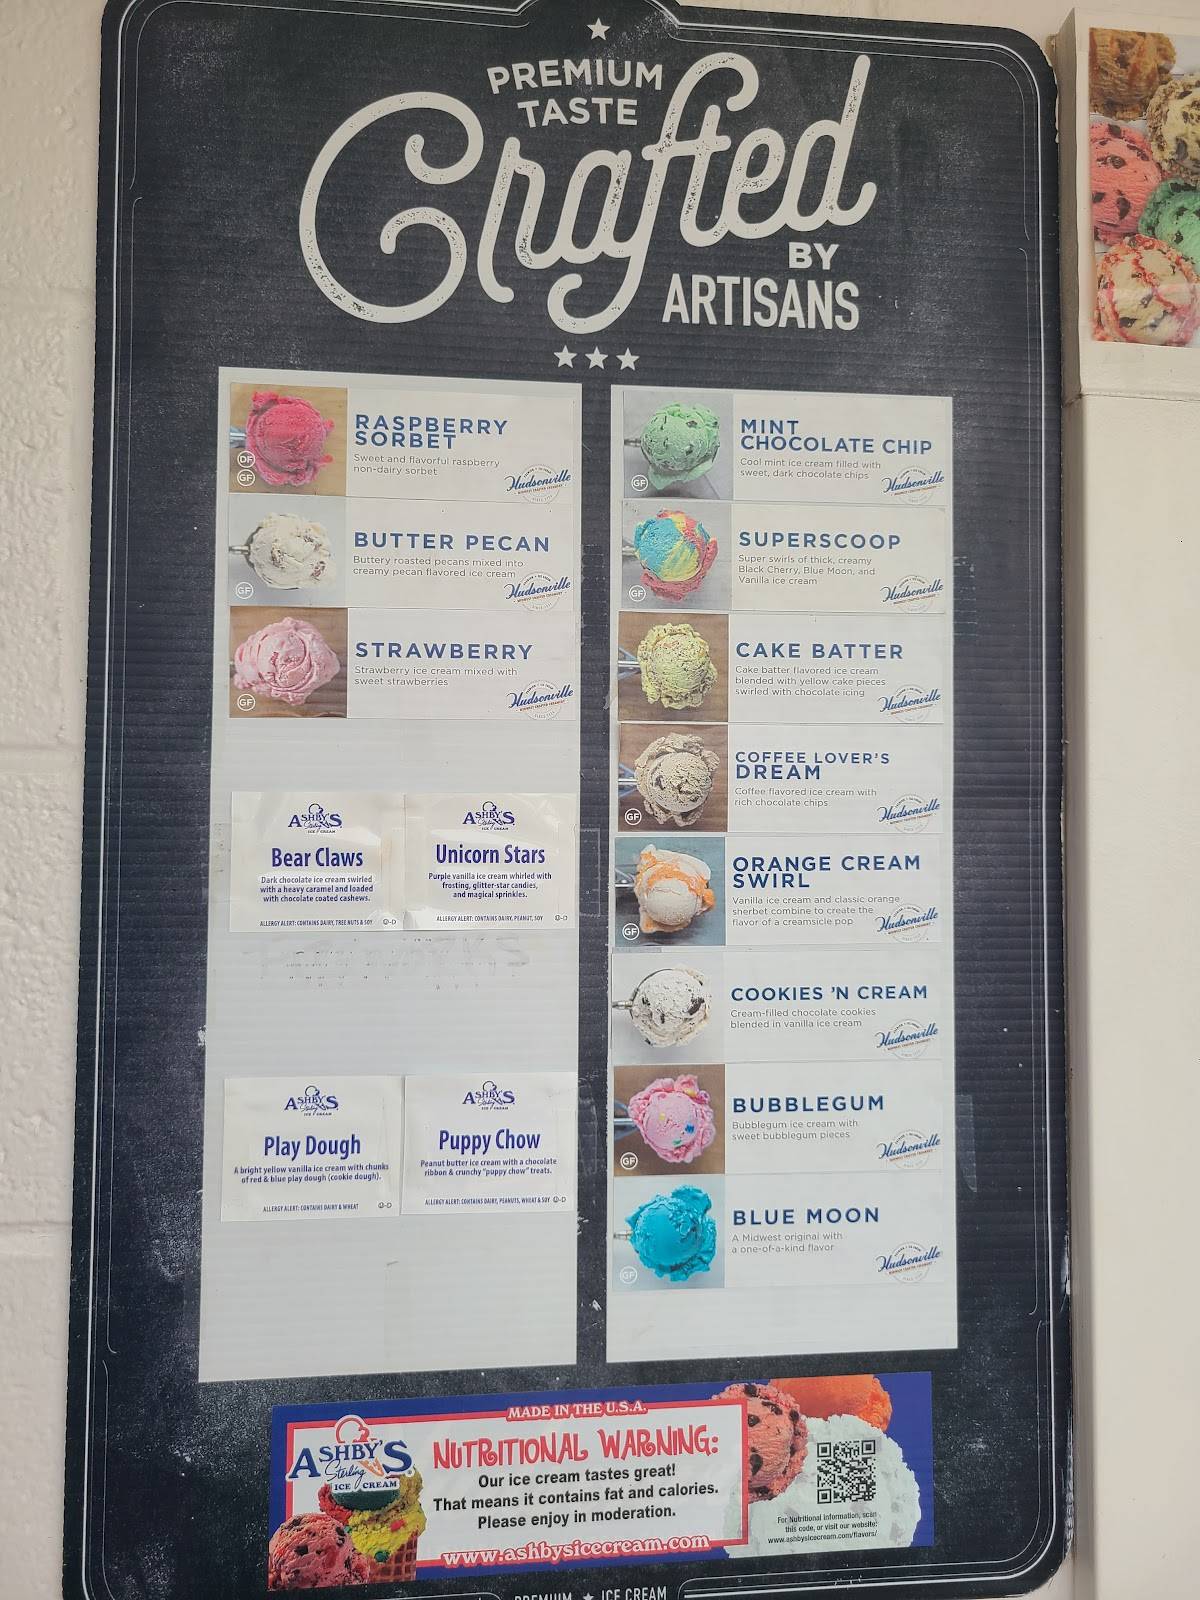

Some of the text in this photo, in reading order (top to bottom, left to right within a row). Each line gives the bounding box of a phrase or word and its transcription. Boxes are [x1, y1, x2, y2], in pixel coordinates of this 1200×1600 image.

[486, 58, 664, 95] PREMIUM
[516, 97, 639, 128] TASTE
[299, 52, 877, 335] Crafted
[787, 241, 839, 270] BY
[661, 273, 860, 331] ARTISANS
[356, 414, 507, 434] RASPBERRY
[742, 419, 798, 436] MINT
[356, 431, 456, 449] SORBET
[741, 435, 932, 454] CHOCOLATE CHIP
[354, 454, 499, 469] Sweet and flavorful raspberry
[354, 465, 438, 476] non-dairy sorbet
[504, 469, 571, 491] Hudsonville
[881, 470, 944, 493] Hudsonville
[355, 532, 548, 552] BUTTER PECAN
[740, 532, 900, 549] SUPERSCOOP
[354, 554, 525, 569] Buttery roasted pecans mixed into
[353, 567, 389, 576] creamy
[426, 568, 465, 576] flavored
[486, 569, 515, 579] cream
[504, 576, 571, 599] Hudsonville
[880, 579, 944, 602] Hudsonville
[356, 642, 532, 659] STRAWBERRY
[736, 643, 902, 659] CAKE BATTER
[508, 684, 574, 708] Hudsonville
[877, 688, 942, 713] Hudsonville
[736, 752, 889, 766] COFFEE LOVER'S
[737, 763, 820, 779] DREAM
[876, 798, 941, 822] Hudsonville
[272, 848, 363, 866] Bear Claws
[437, 844, 545, 863] Unicorn Stars
[733, 856, 919, 871] ORANGE CREAM
[261, 876, 278, 886] Dark
[279, 876, 312, 886] chocolate
[314, 876, 323, 885] ice
[348, 875, 372, 885] swirled
[734, 873, 810, 888] SWIRL
[874, 907, 938, 933] Hudsonville
[732, 987, 822, 1001] COOKIES
[858, 986, 926, 999] CREAM
[731, 1008, 876, 1018] Cream-filled chocolate cookies
[731, 1019, 769, 1029] blended
[784, 1019, 814, 1029] vanilla
[817, 1019, 830, 1028] ice
[833, 1018, 862, 1029] cream
[874, 1023, 938, 1048] Hudsonville
[734, 1096, 883, 1112] BUBBLEGUM
[733, 1120, 787, 1132] Bubblegum
[790, 1120, 803, 1131] ice
[839, 1119, 858, 1130] with
[440, 1129, 540, 1155] Puppy Chow
[732, 1129, 850, 1143] sweet bubblegum pieces
[265, 1134, 360, 1160] Play Dough
[876, 1133, 941, 1159] Hudsonville
[421, 1160, 445, 1170] Peanut
[447, 1159, 468, 1169] butter
[470, 1159, 479, 1169] ice
[481, 1160, 501, 1169] cream
[503, 1158, 518, 1168] with
[526, 1158, 556, 1168] chocolate
[734, 1208, 878, 1225] BLUE MOON
[732, 1232, 740, 1242] A
[743, 1233, 781, 1242] Midwest
[785, 1232, 819, 1243] original
[741, 1242, 804, 1254] one-of-a-kind
[808, 1243, 834, 1252] flavor
[876, 1246, 941, 1272] Hudsonville
[508, 1401, 646, 1418] MADE IN THE U.S.A.
[433, 1424, 720, 1469] NUTRITIONAL WARNING:
[287, 1440, 413, 1479] ASHBY'S
[324, 1459, 367, 1489] Sterling
[479, 1464, 675, 1487] Our ice cream tastes great!
[362, 1480, 397, 1489] CREAM
[433, 1485, 718, 1511] That means it contains fat and calories.
[479, 1508, 676, 1529] Please enjoy in moderation.
[601, 1586, 667, 1600] ICE CREAM
